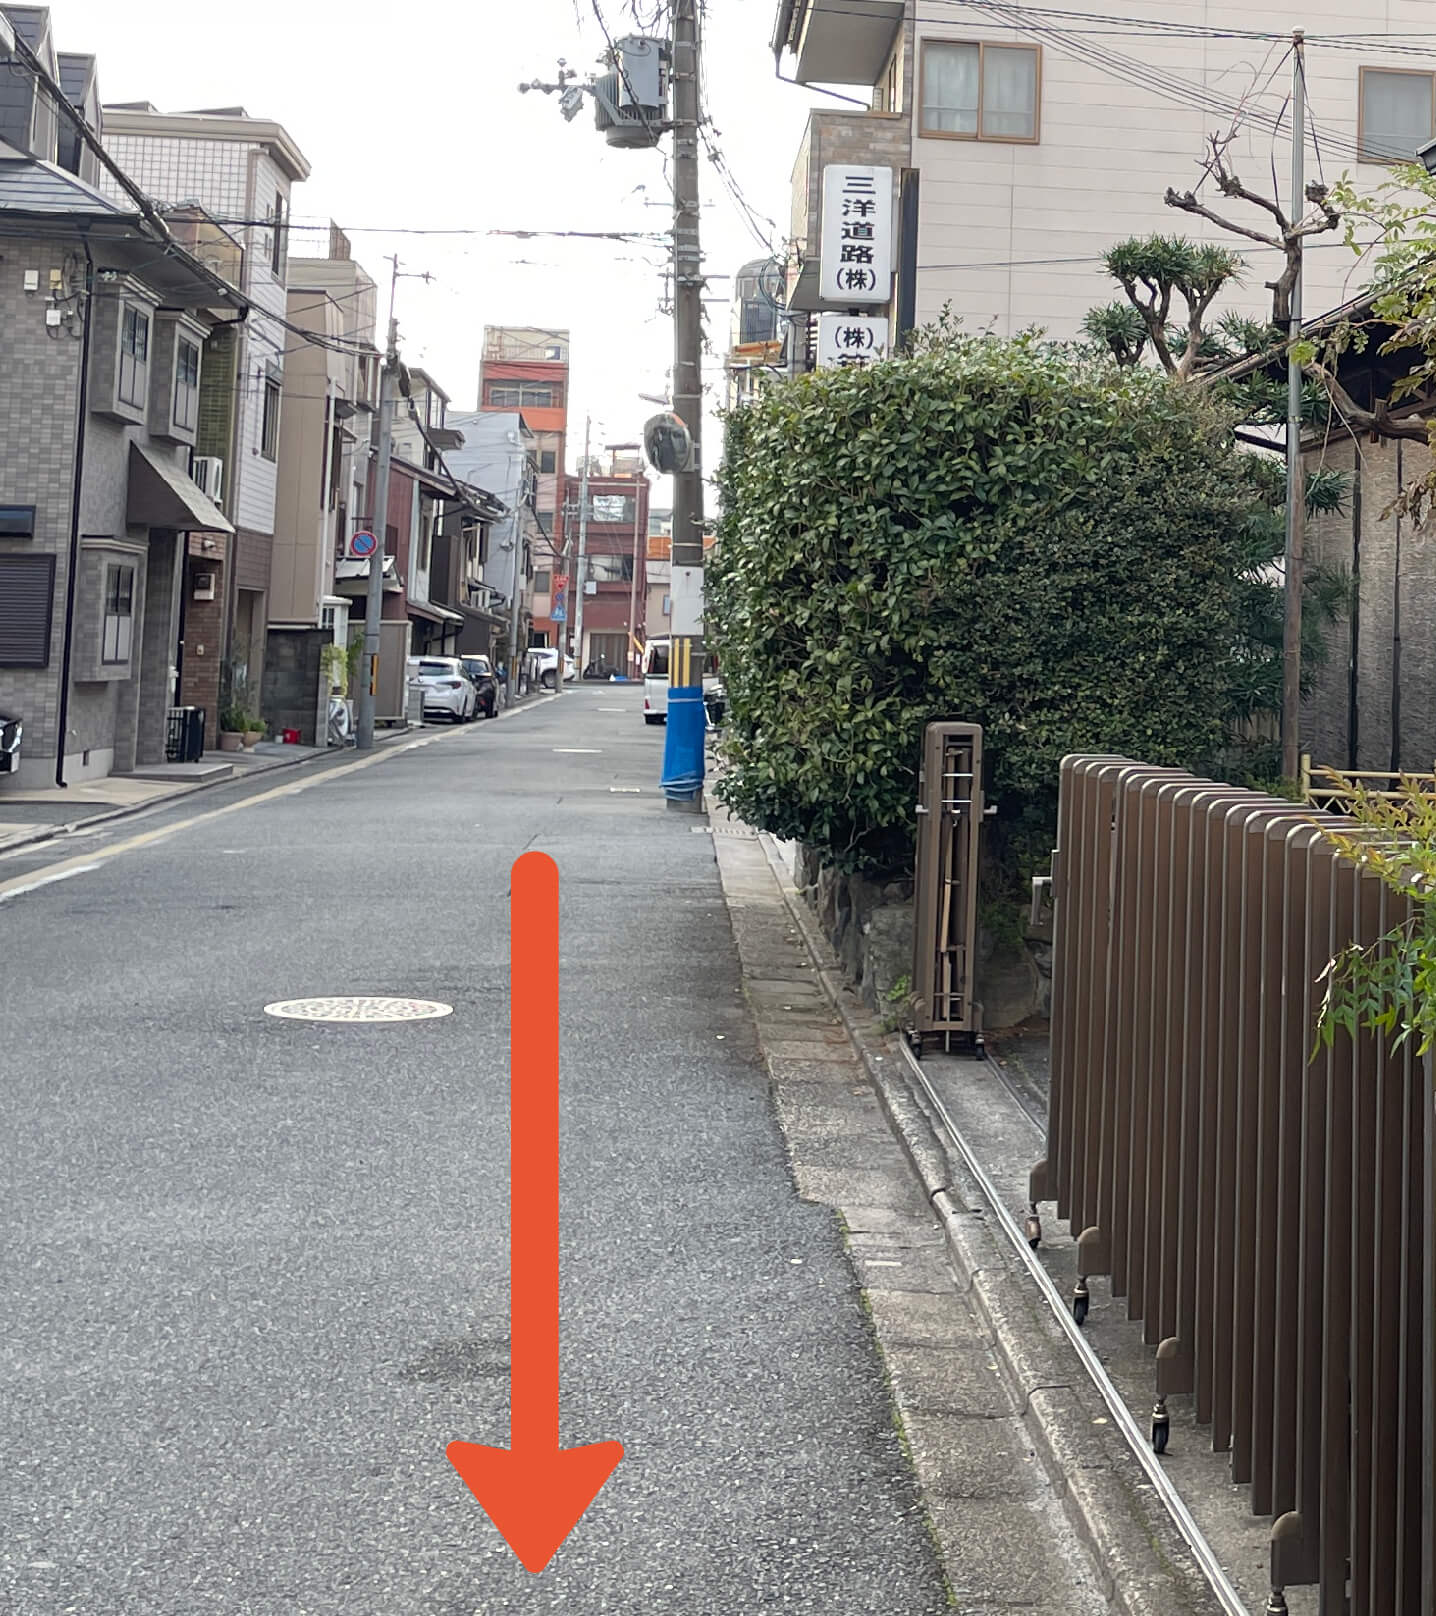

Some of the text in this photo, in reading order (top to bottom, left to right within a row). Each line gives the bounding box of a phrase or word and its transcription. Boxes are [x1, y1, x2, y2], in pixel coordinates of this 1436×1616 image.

[836, 176, 876, 291] 三洋道路(株)
